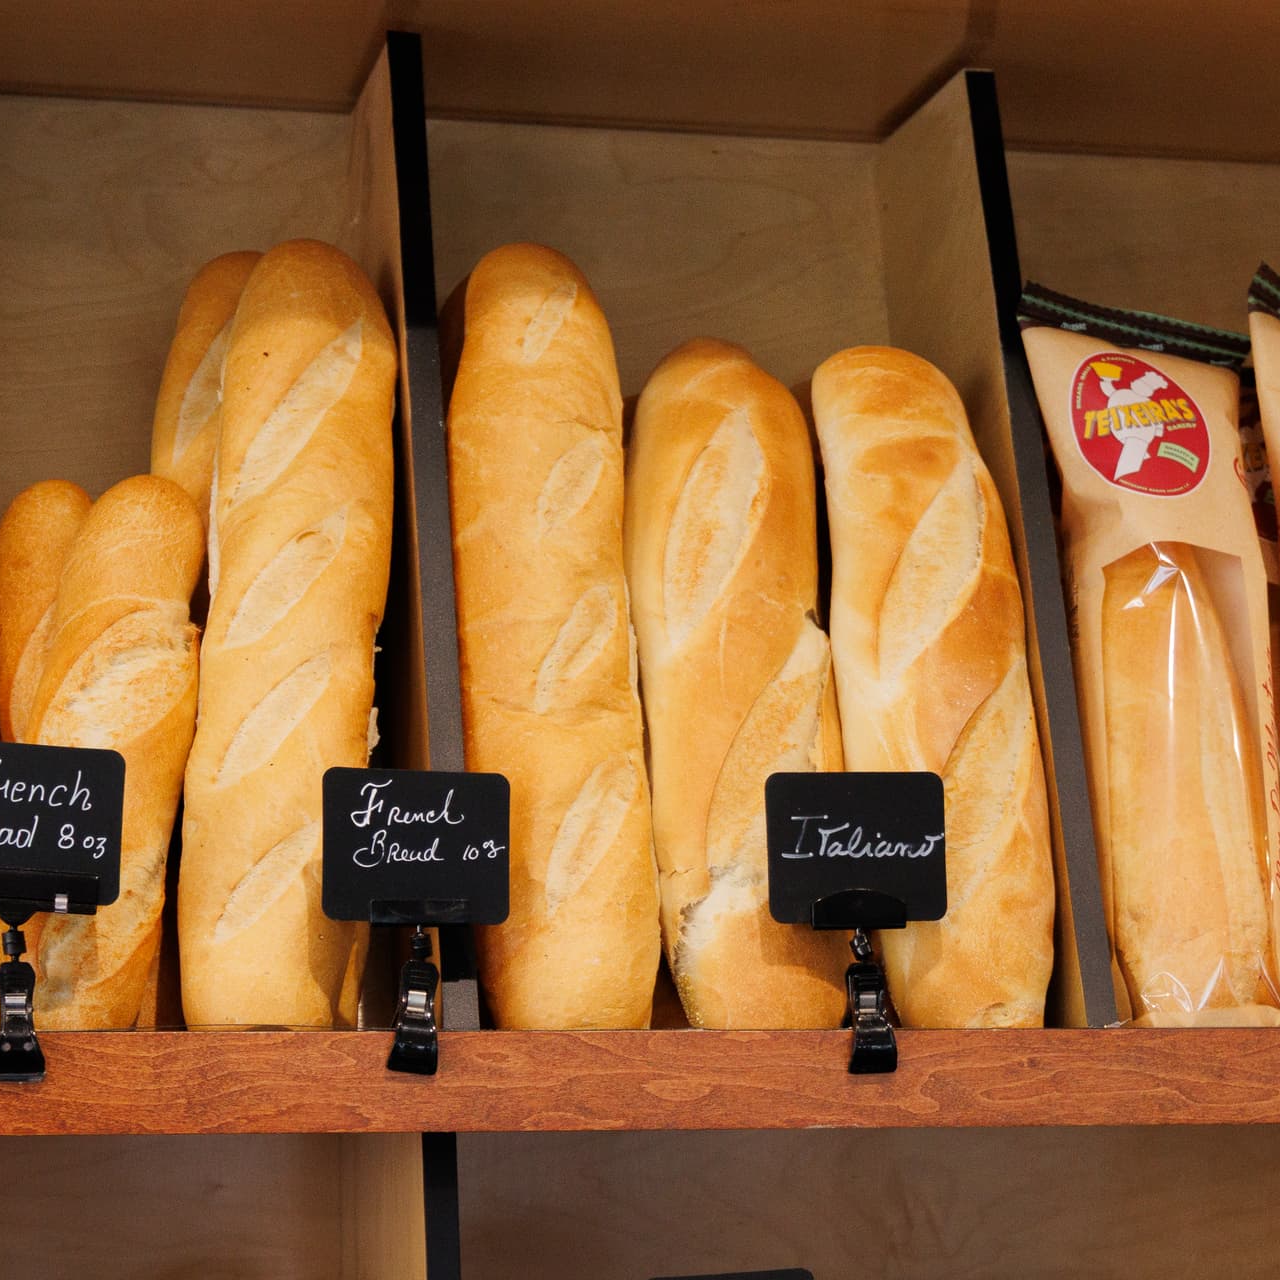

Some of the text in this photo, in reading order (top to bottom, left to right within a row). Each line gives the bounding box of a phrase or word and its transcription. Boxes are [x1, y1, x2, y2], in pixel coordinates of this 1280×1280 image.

[1083, 398, 1196, 439] TEIXEIRA'S
[350, 779, 465, 829] French
[56, 821, 75, 848] 8
[352, 829, 446, 868] Bread
